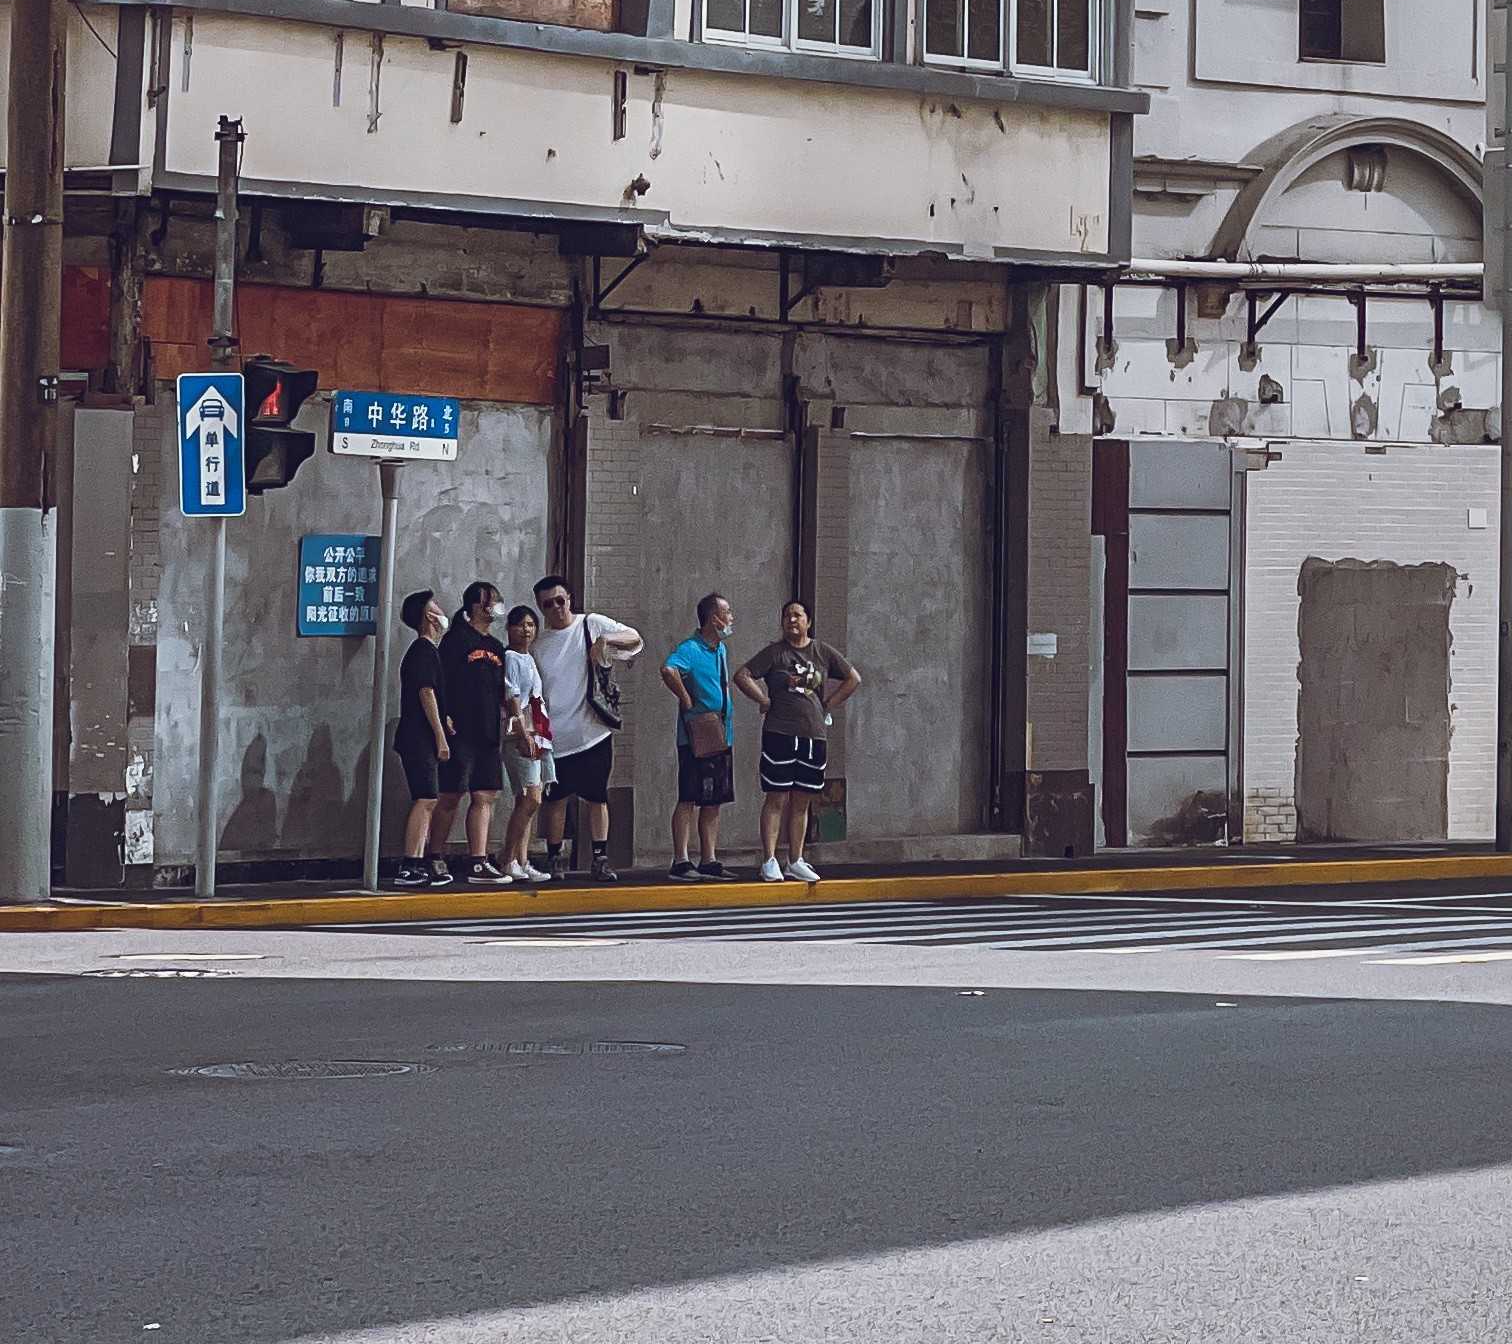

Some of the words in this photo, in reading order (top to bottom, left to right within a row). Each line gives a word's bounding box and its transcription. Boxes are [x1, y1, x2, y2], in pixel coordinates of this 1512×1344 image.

[367, 401, 429, 431] 中华路
[442, 405, 453, 421] 北
[342, 436, 349, 449] S
[442, 443, 450, 455] N
[205, 431, 221, 496] 单行道
[324, 546, 365, 563] 公开公平
